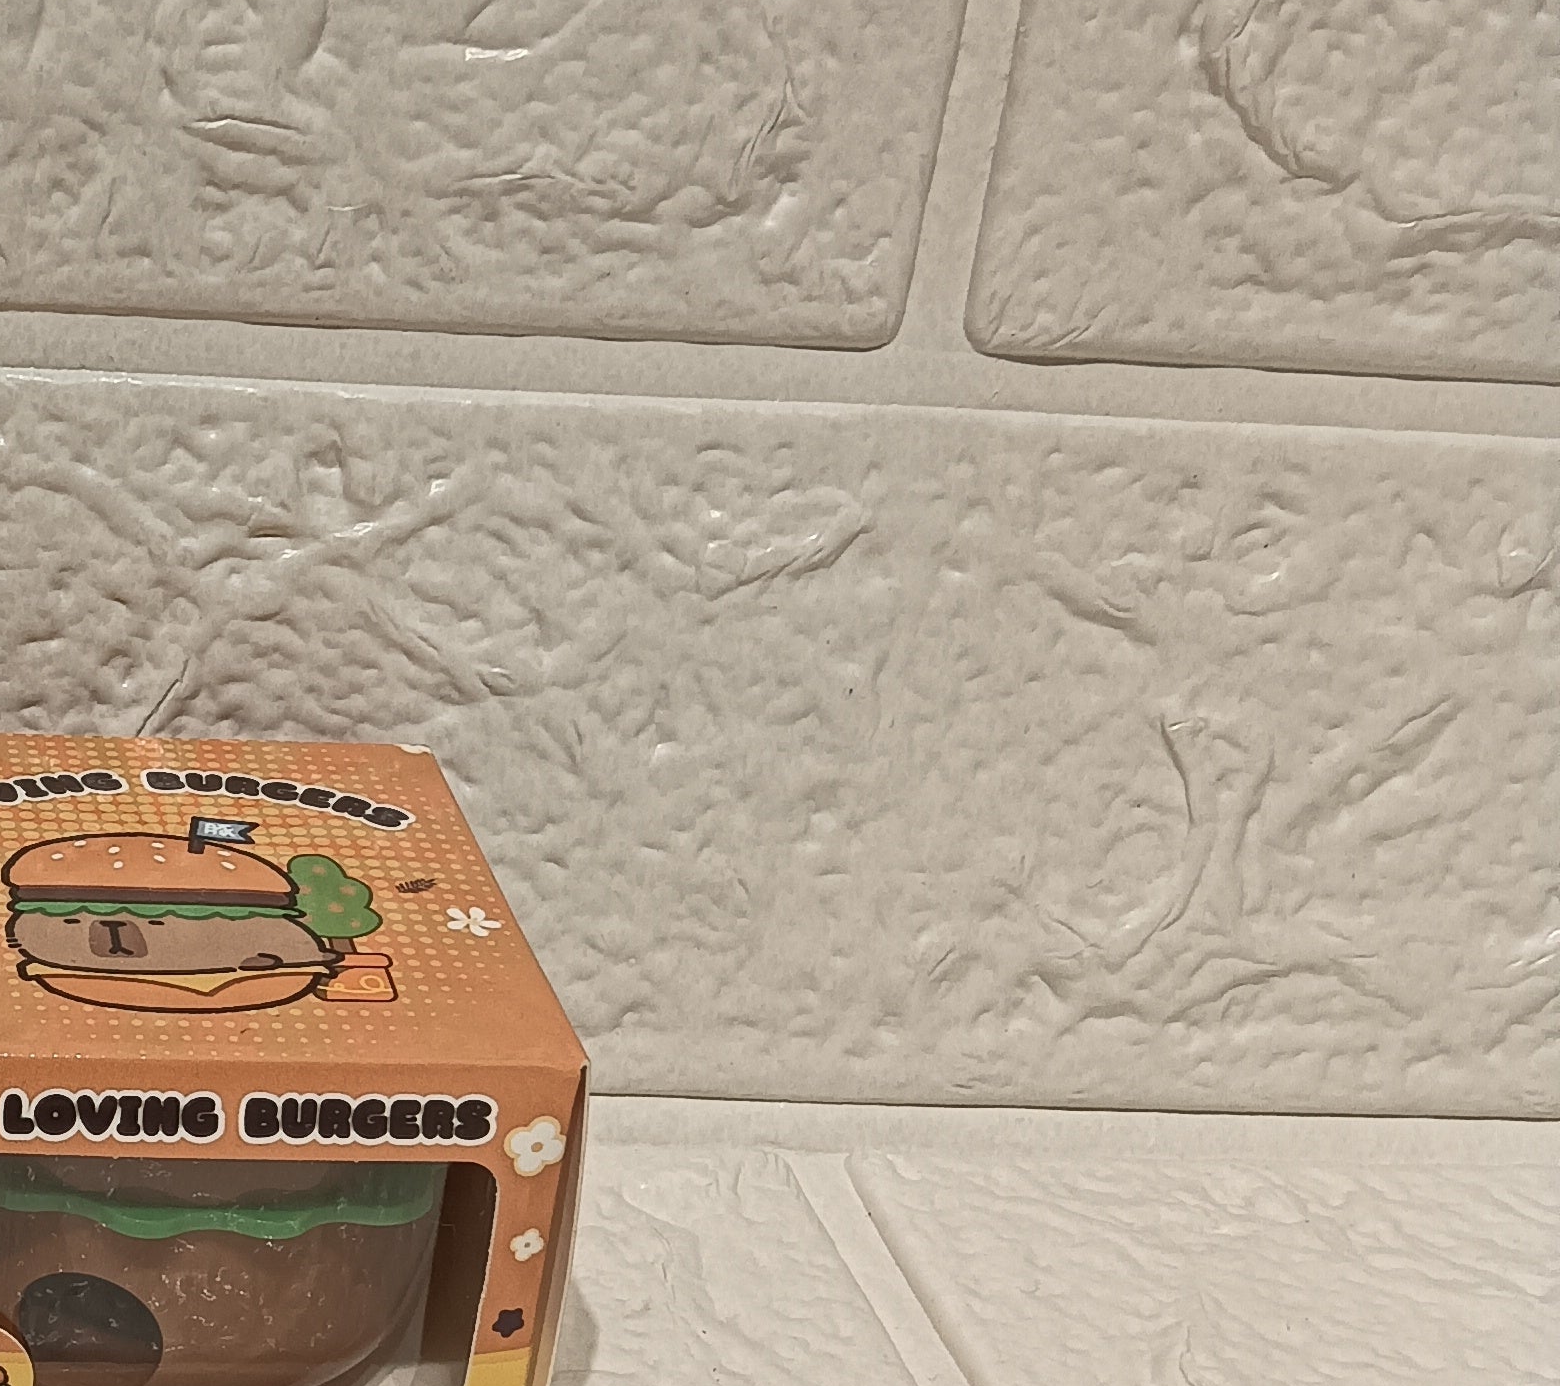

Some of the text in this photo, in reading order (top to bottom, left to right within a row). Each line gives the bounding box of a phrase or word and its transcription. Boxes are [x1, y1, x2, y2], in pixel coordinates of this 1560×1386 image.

[145, 771, 410, 829] BURGERS
[2, 1093, 492, 1141] LOVING BURGERS
